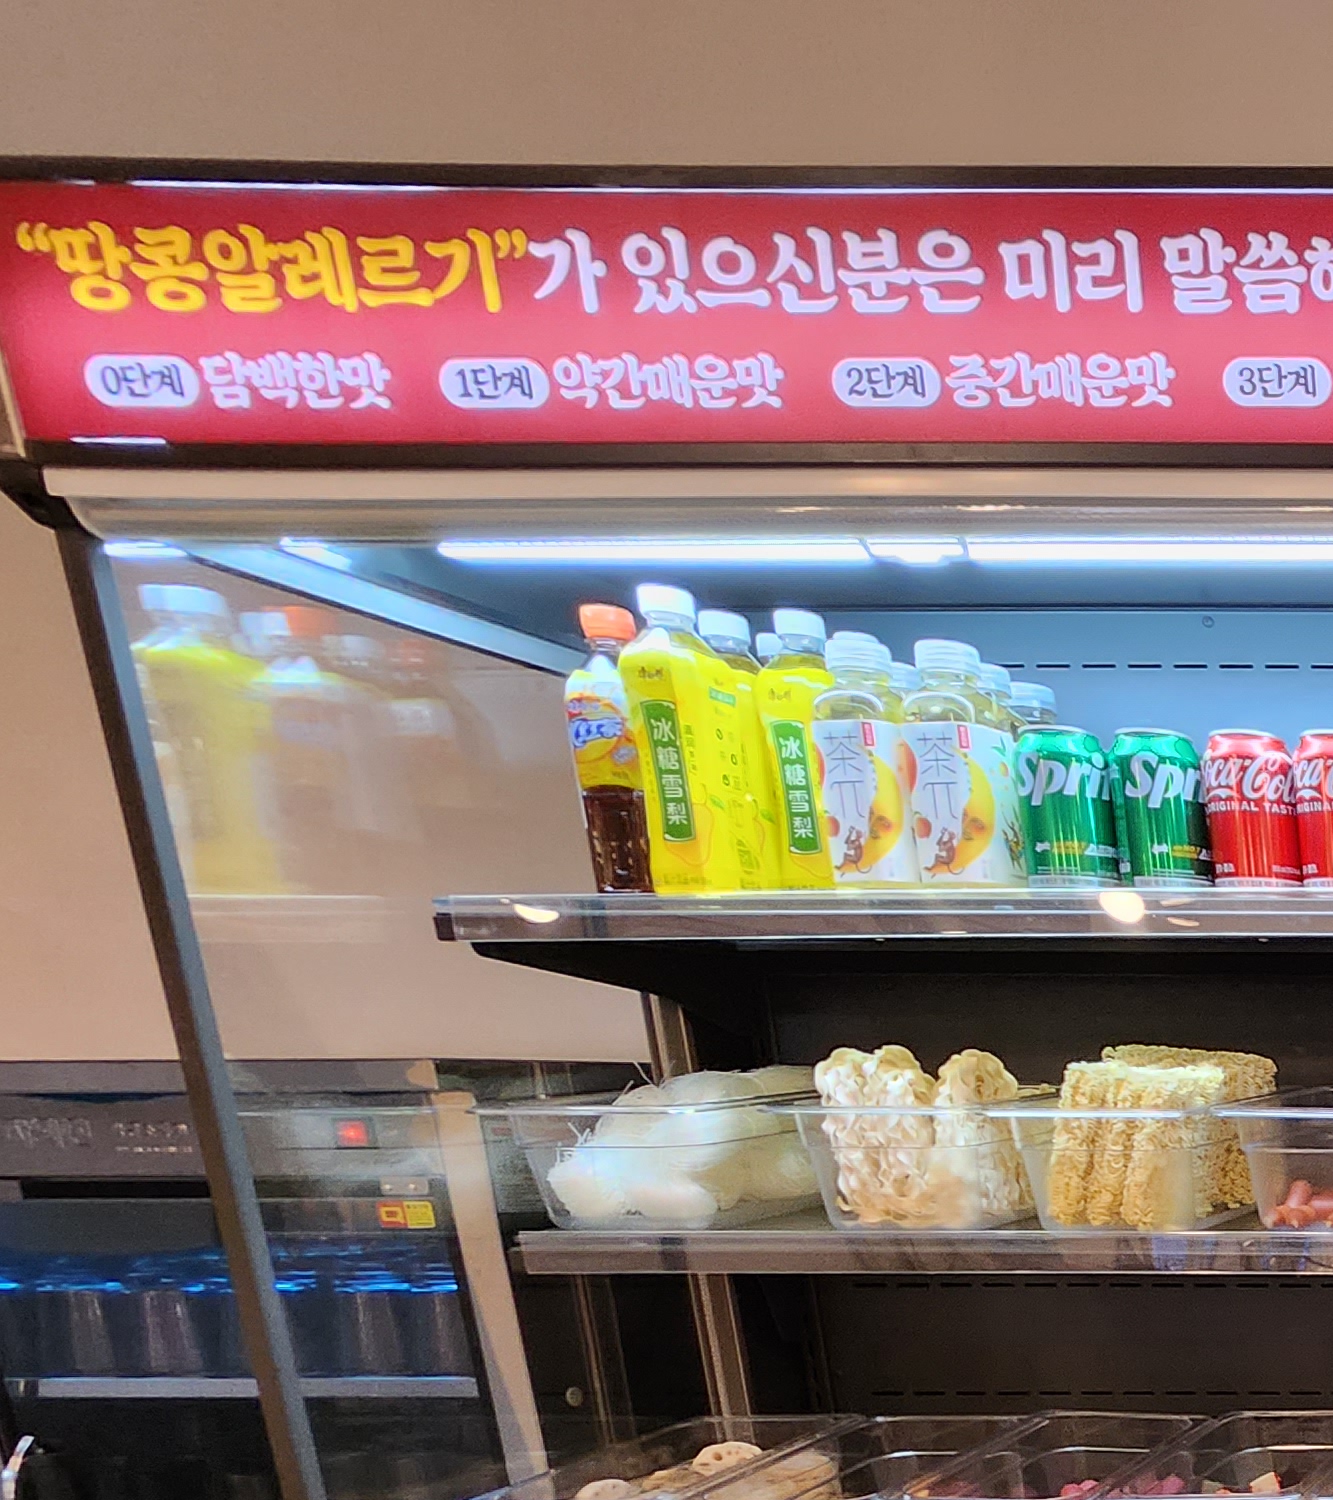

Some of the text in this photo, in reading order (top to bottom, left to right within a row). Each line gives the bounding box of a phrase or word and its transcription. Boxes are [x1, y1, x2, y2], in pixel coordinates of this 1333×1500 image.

[622, 226, 984, 315] 있으신분은
[1000, 229, 1143, 313] 미리
[100, 361, 185, 400] 0단계
[199, 352, 392, 411] 담백한맛
[457, 364, 536, 402] 1단계
[553, 352, 784, 410] 약간매운맛
[846, 364, 927, 400] 2단계
[946, 353, 1176, 410] 중간매운맛
[1238, 363, 1318, 399] 3단계
[651, 718, 688, 825] 冰糖雪梨
[779, 737, 813, 838] 冰糖雪梨
